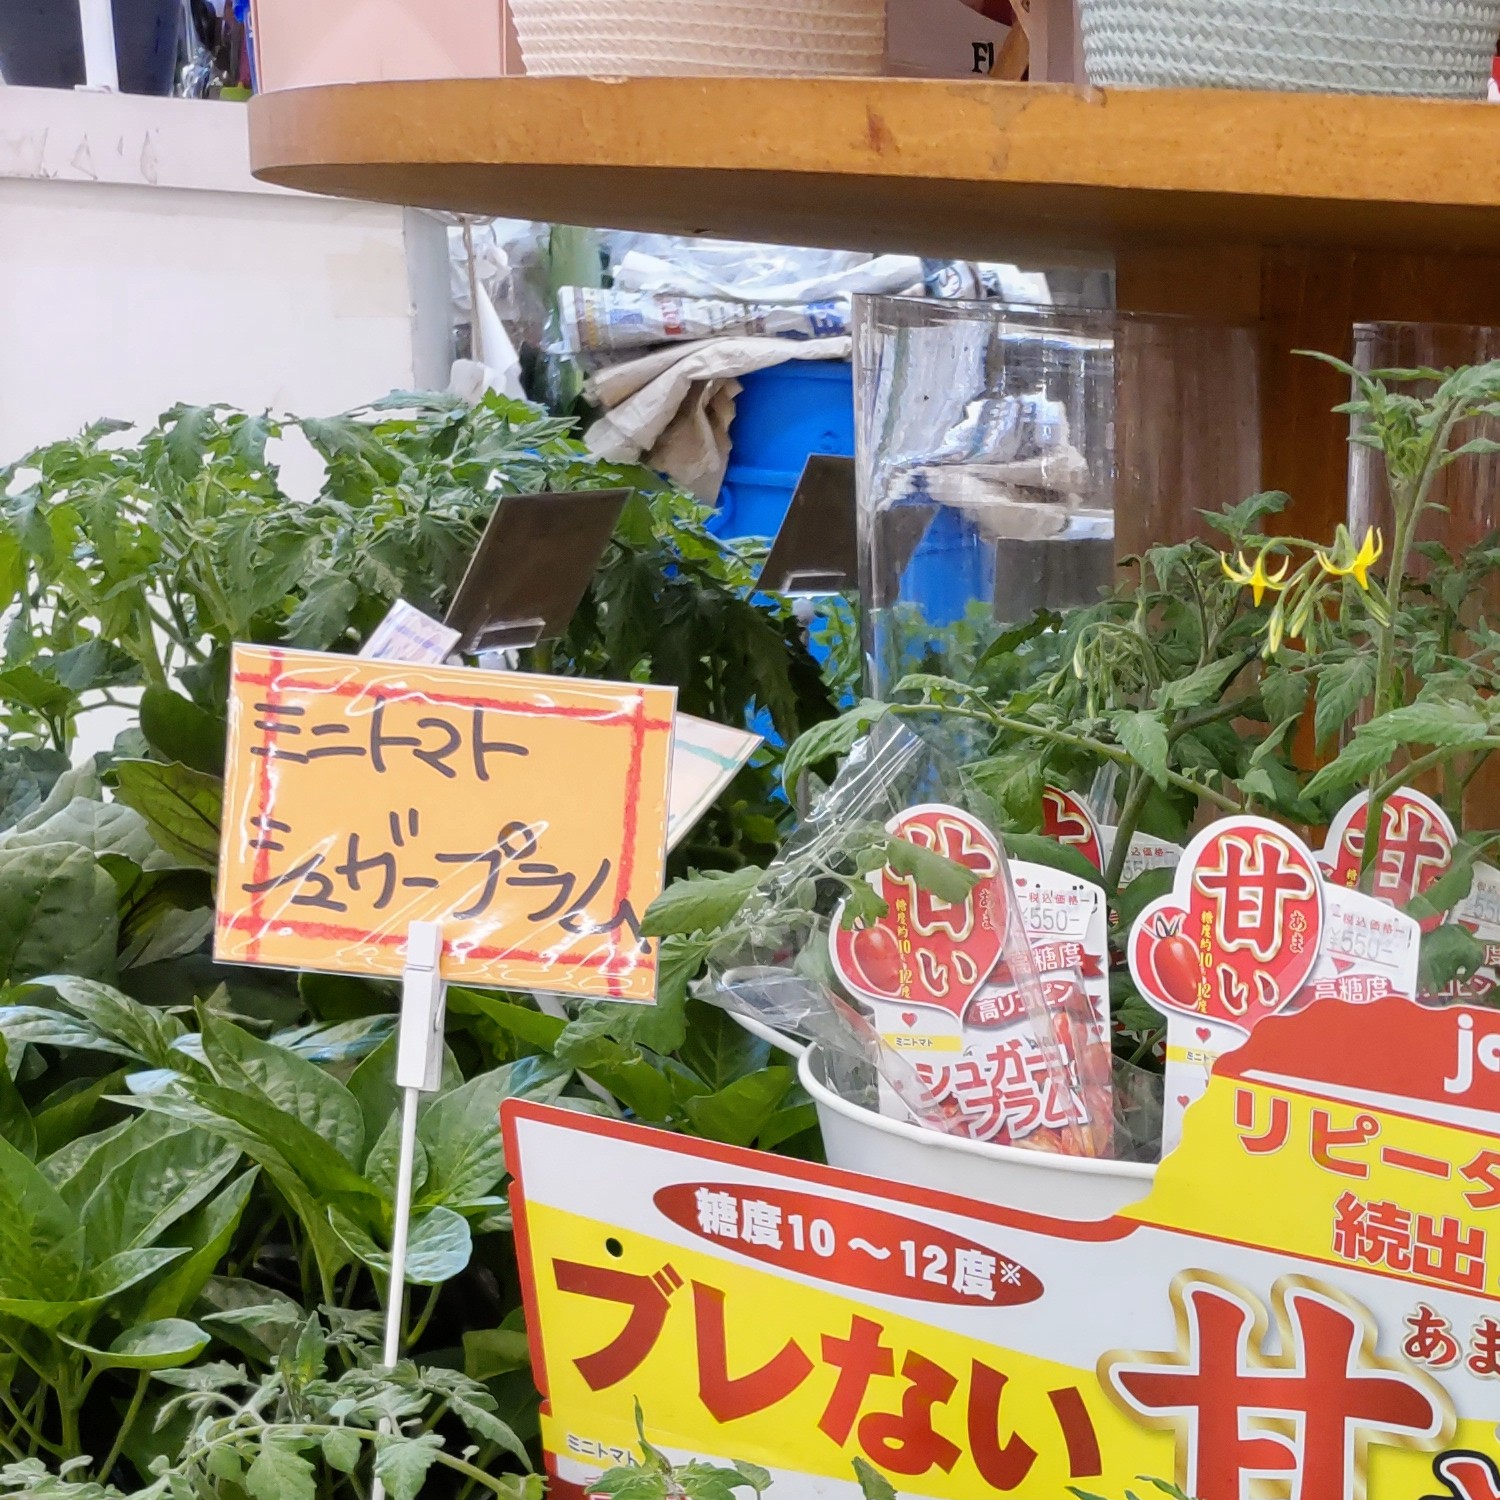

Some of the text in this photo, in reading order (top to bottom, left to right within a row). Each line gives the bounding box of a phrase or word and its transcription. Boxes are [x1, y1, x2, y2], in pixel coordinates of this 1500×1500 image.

[250, 694, 529, 781] ミニトマト
[1343, 803, 1451, 901] 甘
[241, 808, 652, 955] シュガープラム
[1028, 890, 1080, 906] 税込価格
[1194, 834, 1316, 1016] 甘い
[1289, 910, 1308, 953] あま
[1012, 941, 1084, 973] 高糖度
[976, 980, 1074, 1022] 高リコピン
[1314, 976, 1390, 1001] 高糖度
[895, 1036, 934, 1048] ミニトマト
[915, 1038, 1066, 1101] シュガー
[963, 1080, 1089, 1138] プラム
[567, 1433, 634, 1465] ミニトマト
